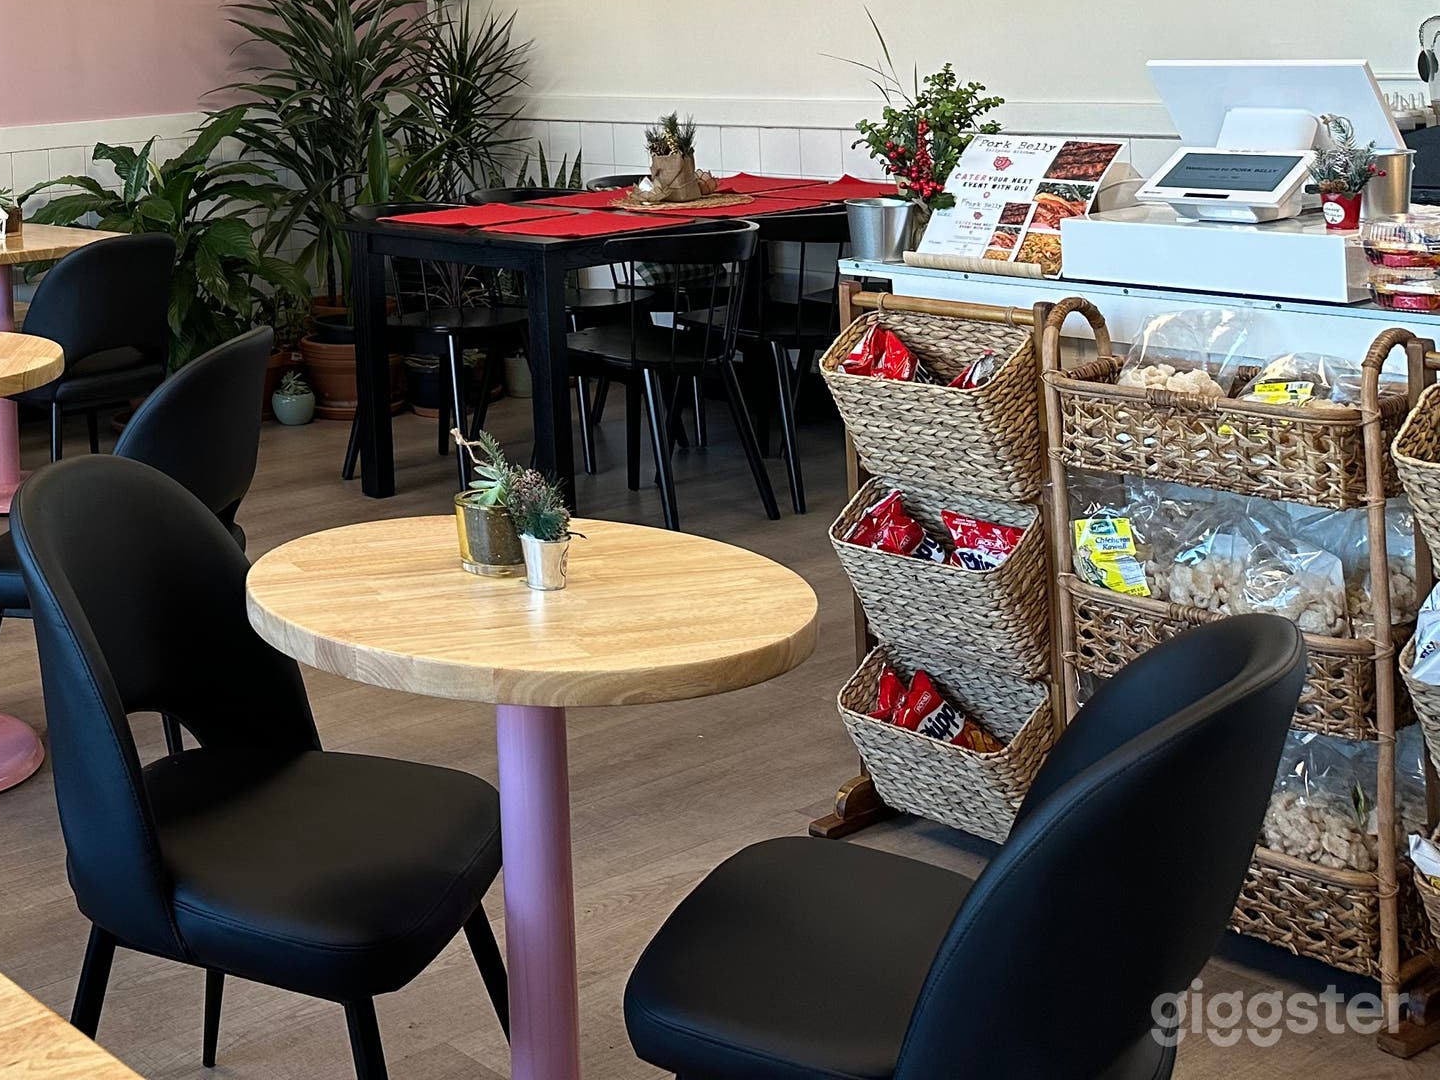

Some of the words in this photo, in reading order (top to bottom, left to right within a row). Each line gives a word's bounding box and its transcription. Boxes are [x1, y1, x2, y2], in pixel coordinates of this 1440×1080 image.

[979, 139, 1012, 149] Pork
[1017, 141, 1058, 153] Belly
[954, 173, 987, 181] CATER
[962, 181, 989, 189] EVENT
